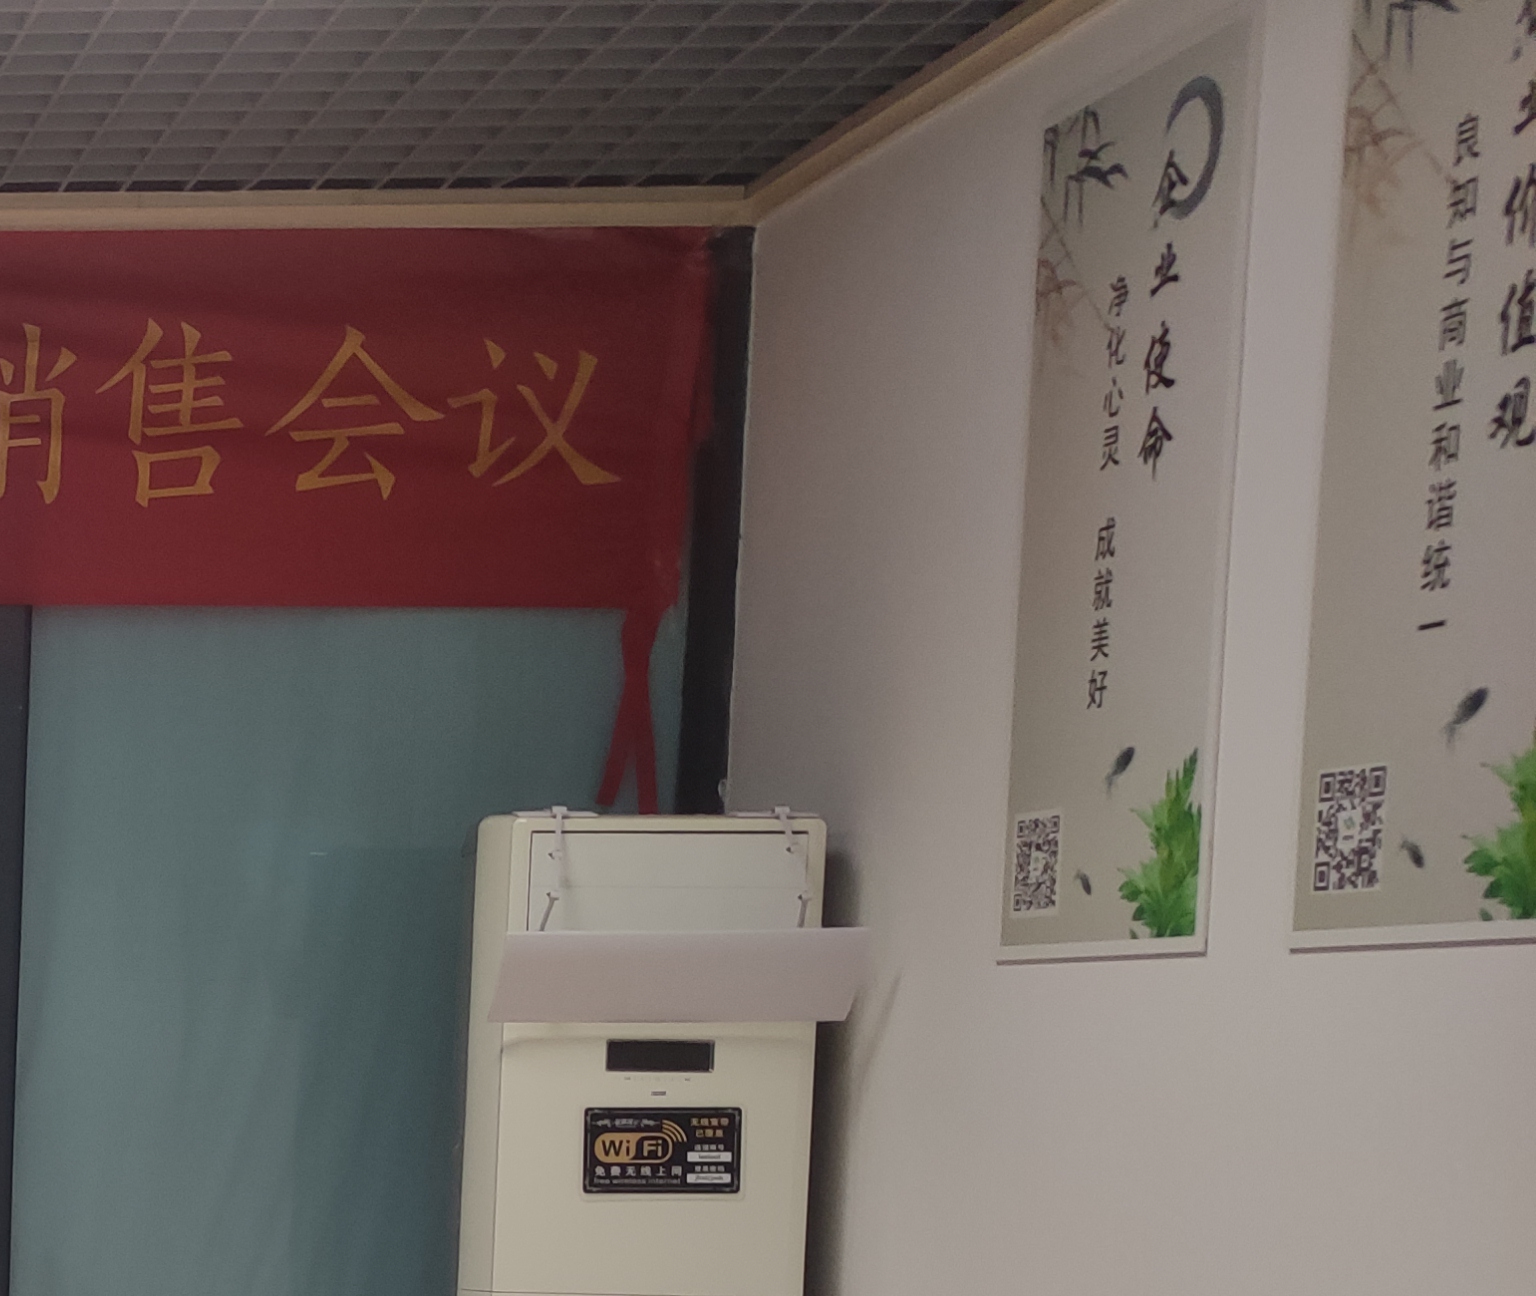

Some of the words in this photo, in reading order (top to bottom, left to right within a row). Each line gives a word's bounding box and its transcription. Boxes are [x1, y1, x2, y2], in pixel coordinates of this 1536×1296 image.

[1099, 275, 1129, 471] 净化心灵
[1137, 148, 1189, 481] 企业使命
[1417, 112, 1479, 631] 良知与商业和谐统一
[1086, 515, 1116, 711] 成就美好
